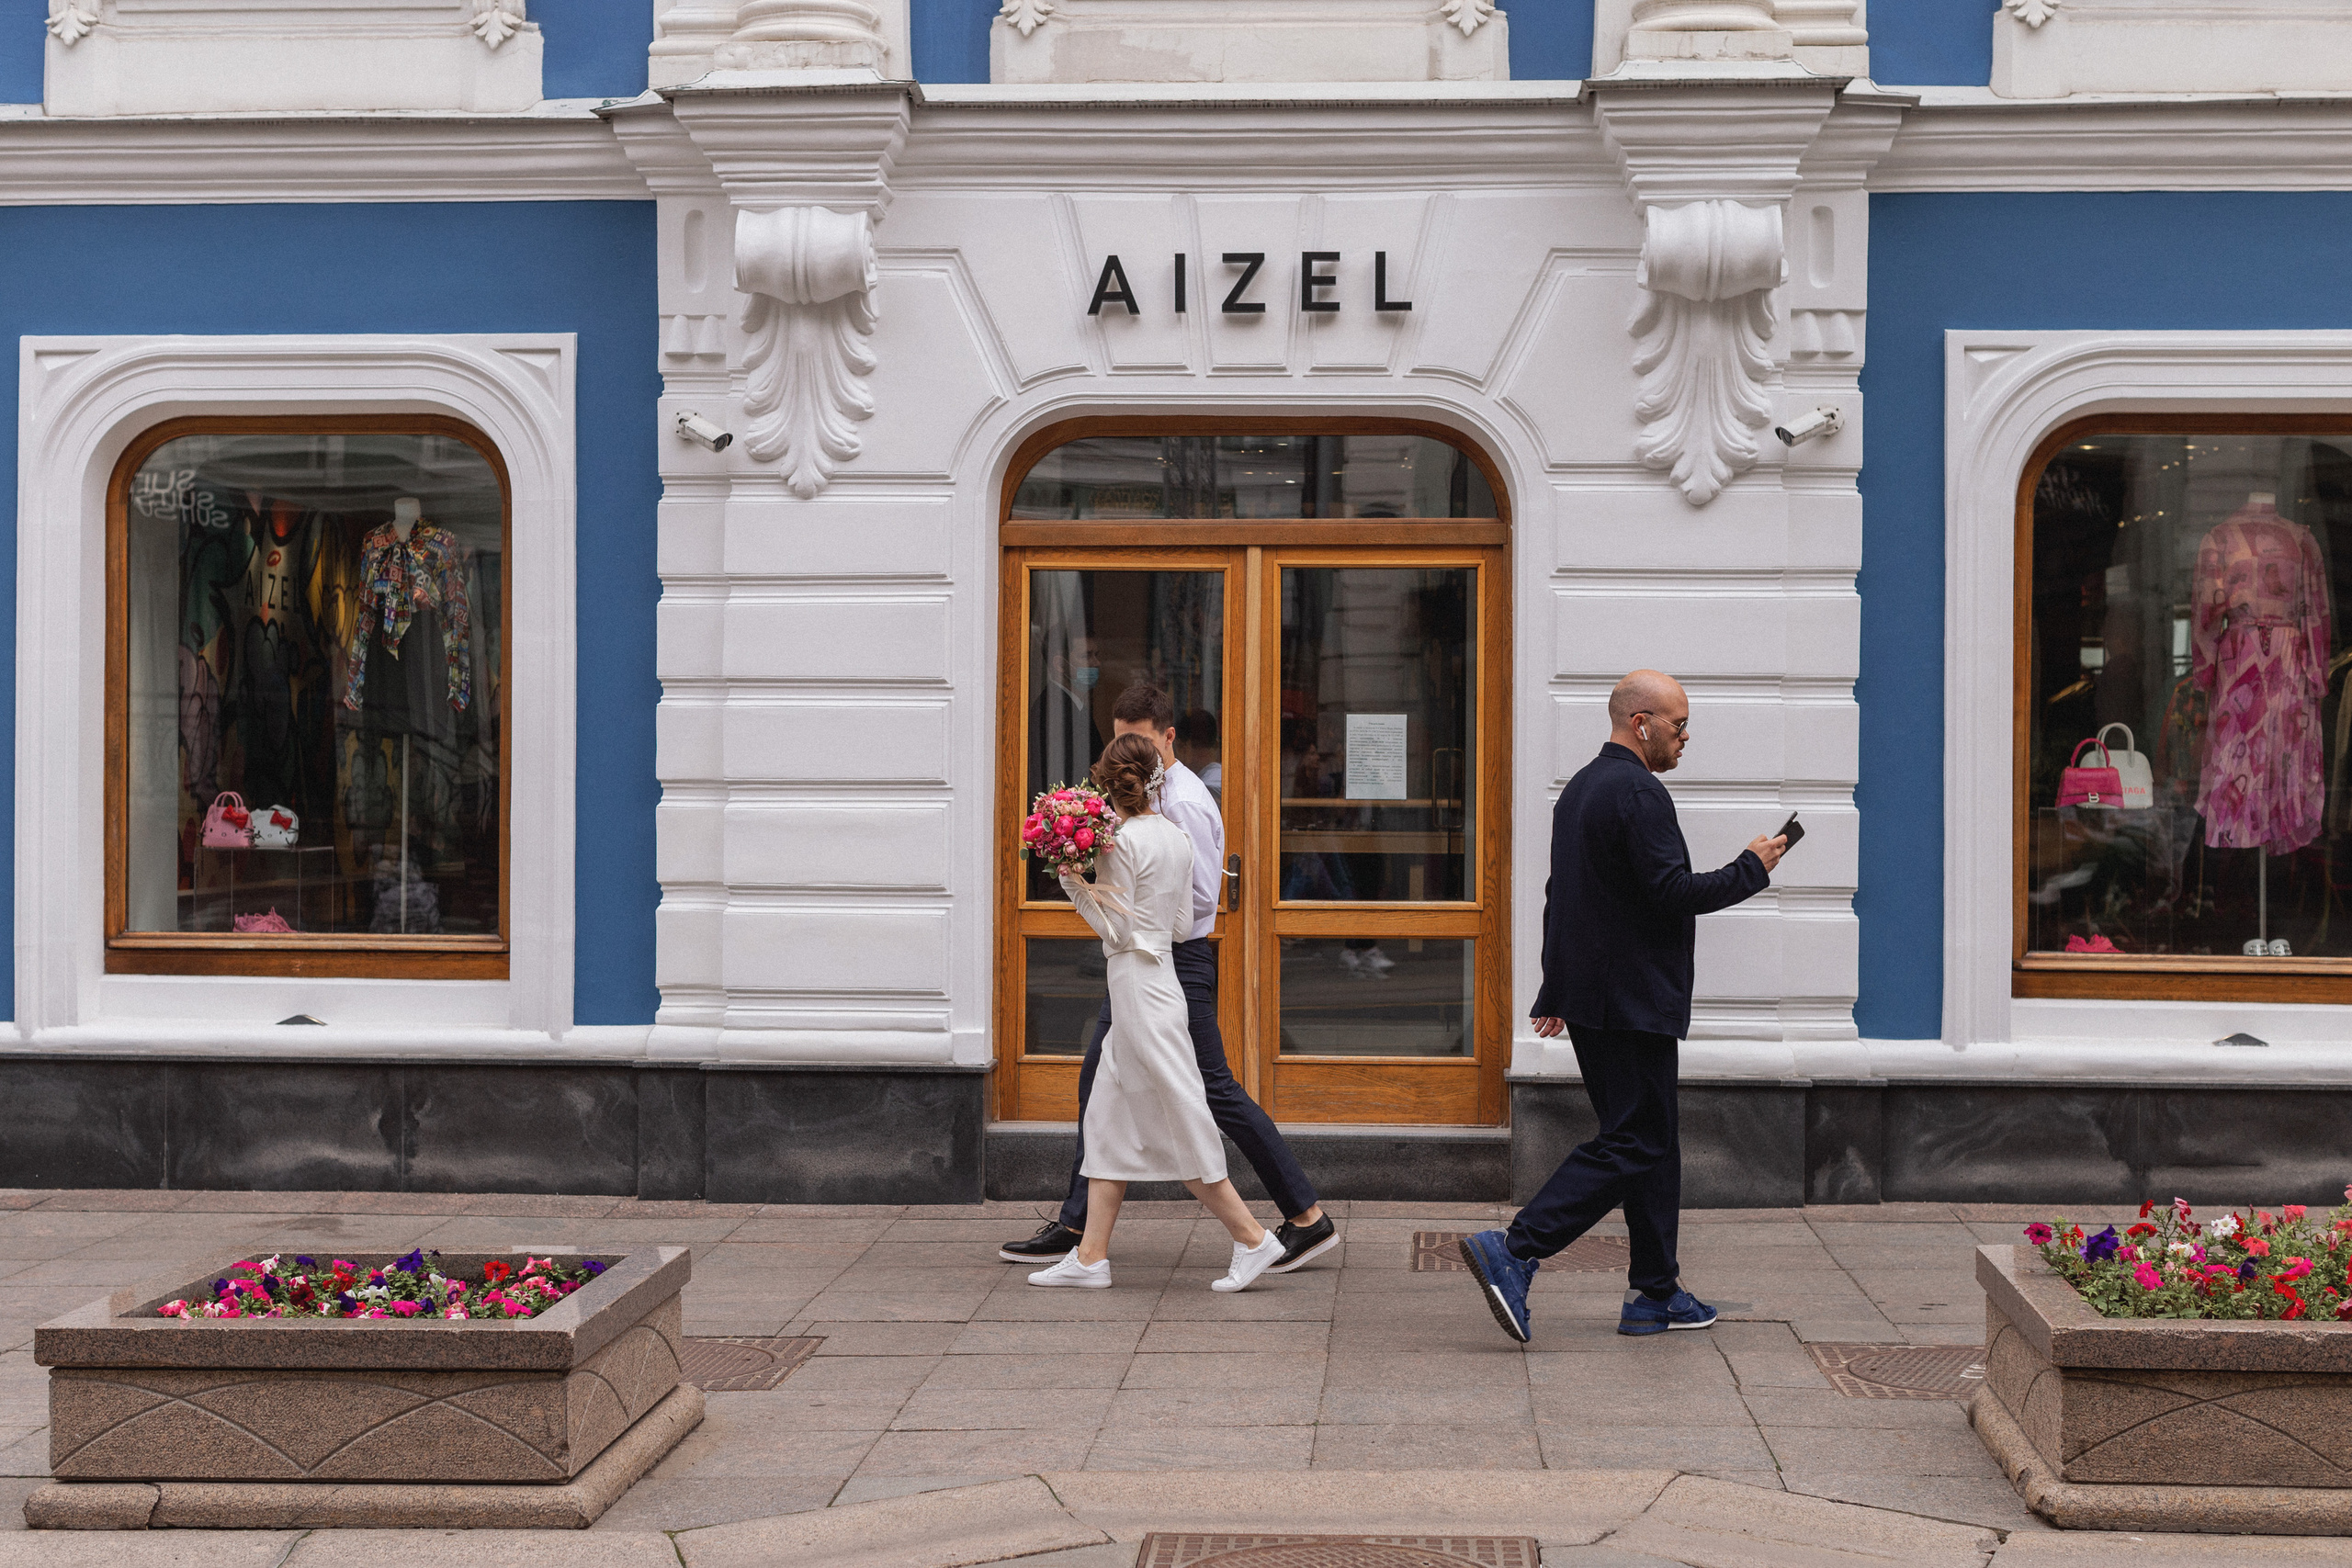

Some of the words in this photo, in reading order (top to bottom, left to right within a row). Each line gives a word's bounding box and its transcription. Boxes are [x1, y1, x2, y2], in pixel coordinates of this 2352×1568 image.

[1087, 251, 1412, 316] AIZEL
[244, 570, 300, 614] AIZEL
[2121, 786, 2146, 795] IAGA
